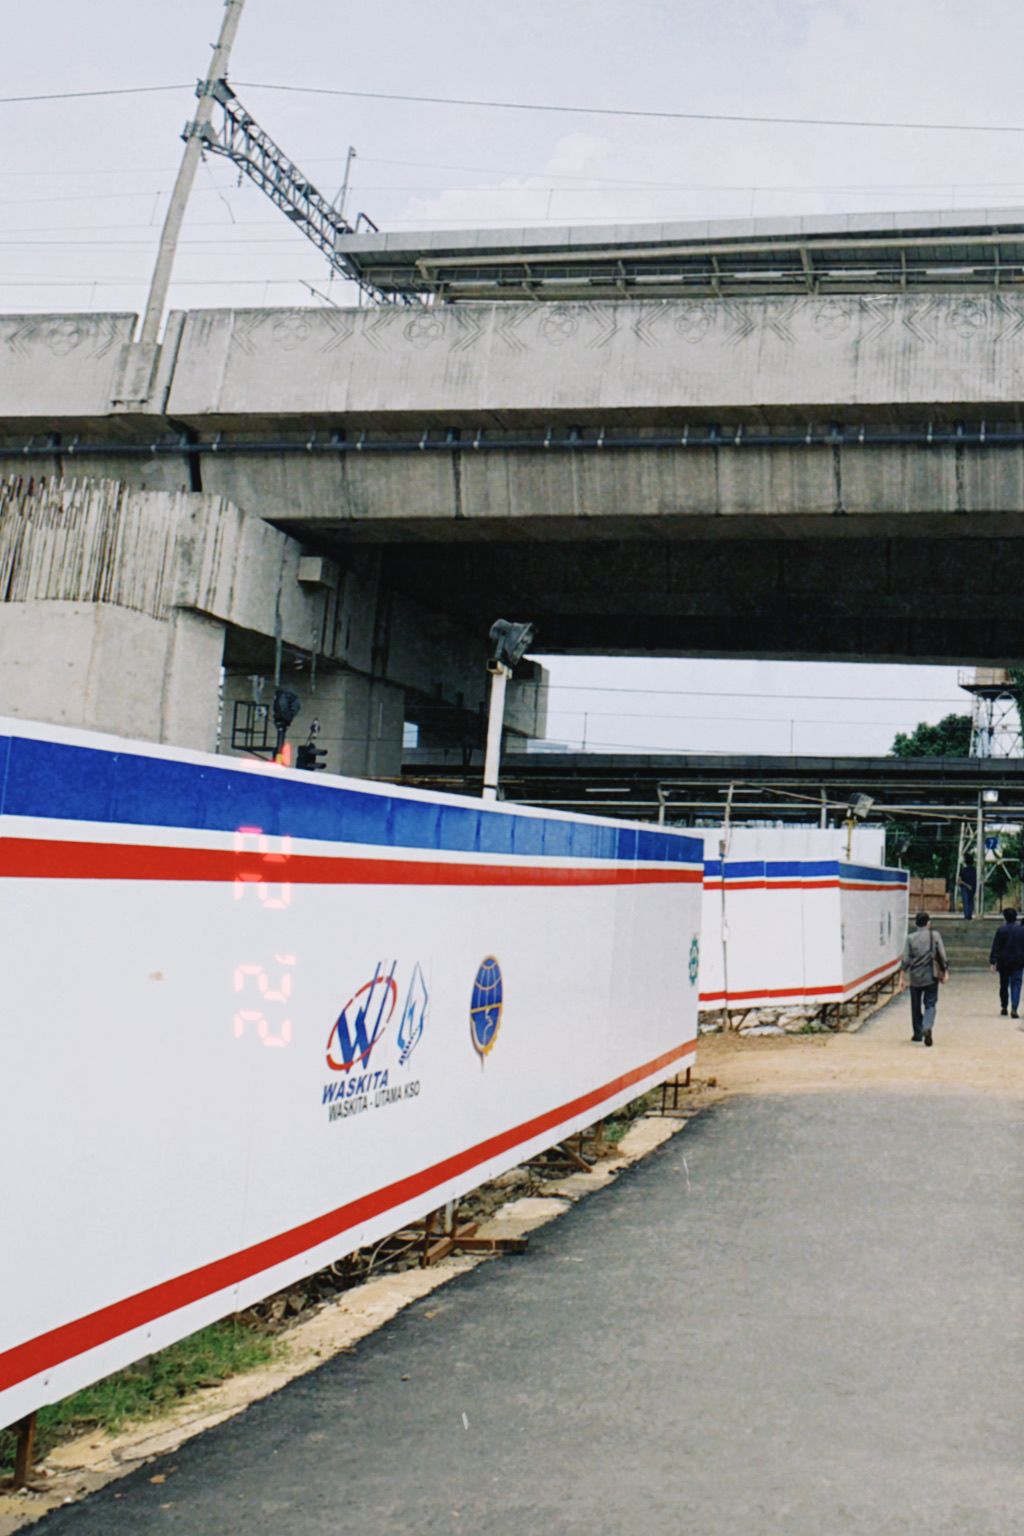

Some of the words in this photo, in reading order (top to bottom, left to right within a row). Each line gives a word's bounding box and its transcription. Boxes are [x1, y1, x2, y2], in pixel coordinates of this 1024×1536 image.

[322, 1068, 389, 1105] WASKITA
[328, 1095, 368, 1123] WASKITA
[374, 1086, 402, 1108] UTAMA
[404, 1080, 420, 1100] KSO
